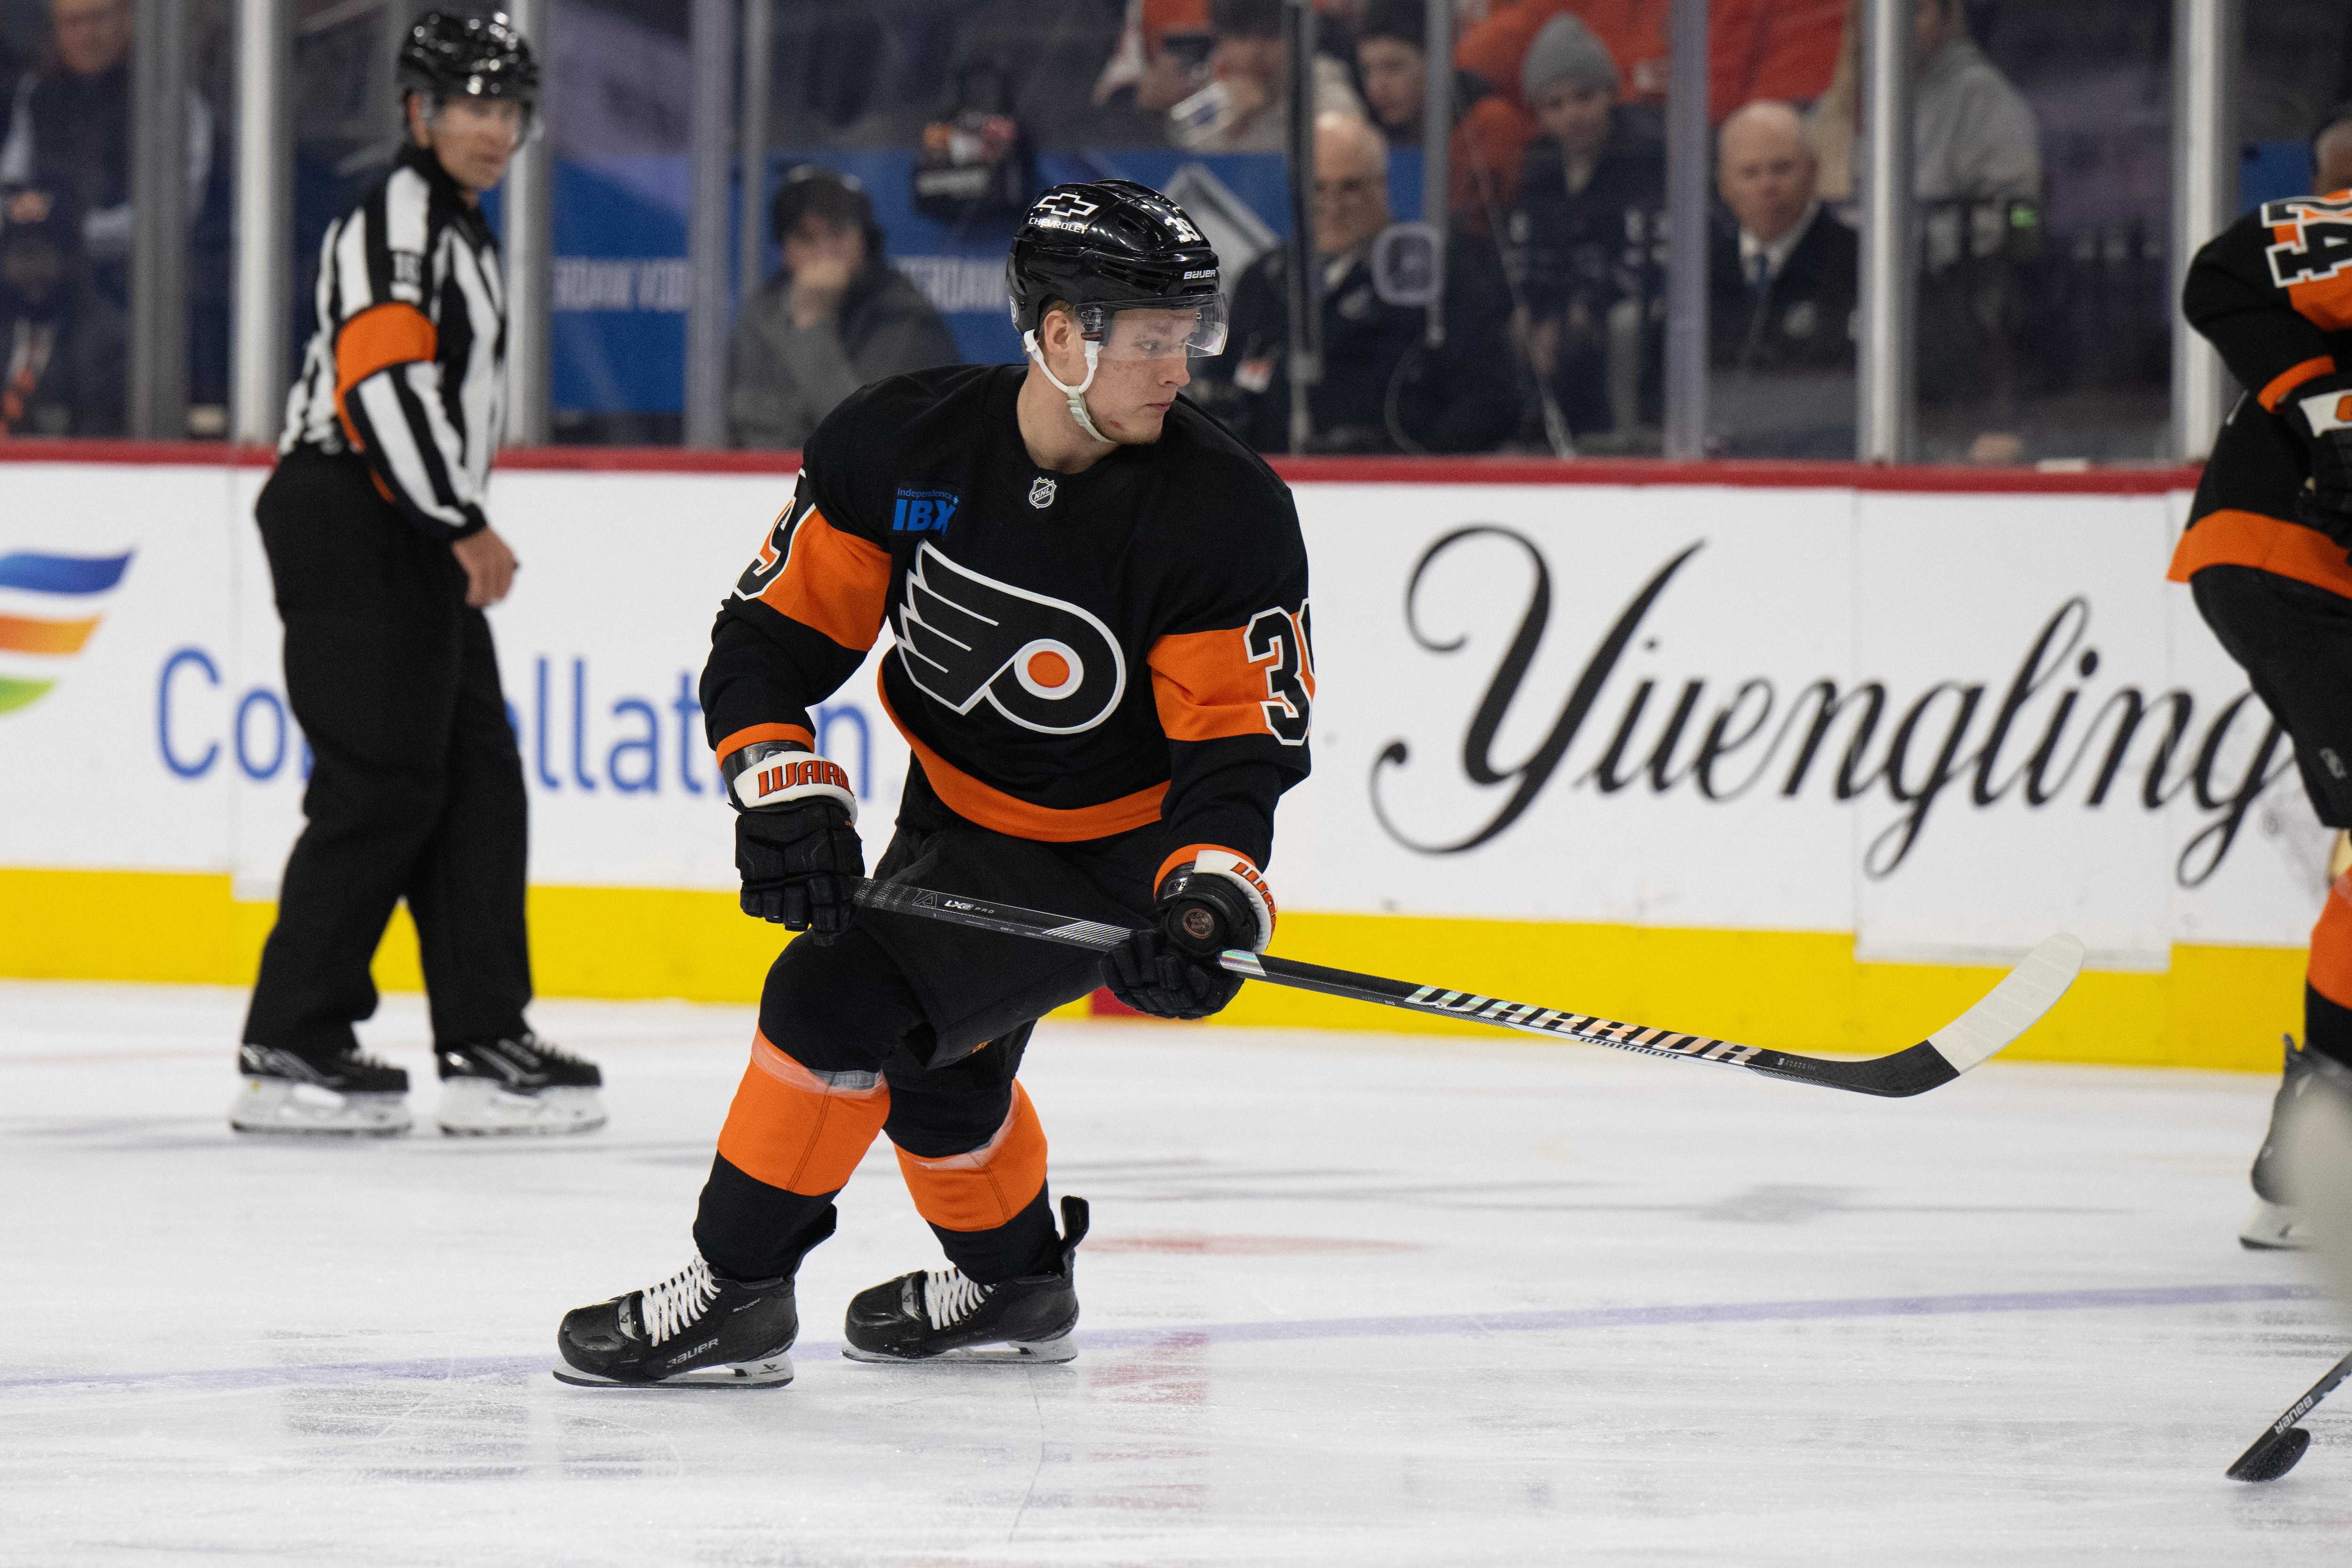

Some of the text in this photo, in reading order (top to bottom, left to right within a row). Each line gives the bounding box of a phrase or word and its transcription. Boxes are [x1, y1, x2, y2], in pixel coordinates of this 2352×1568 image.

[1028, 217, 1087, 234] CHEVROLET
[1164, 216, 1201, 243] 39
[897, 487, 953, 500] Independence
[1034, 487, 1050, 501] NHL
[892, 499, 956, 536] IBX
[1243, 597, 1316, 746] 3
[1368, 521, 2298, 889] Yuengling
[1404, 984, 1763, 1067] WARRIOR
[1580, 1037, 1680, 1060] WARRIOR
